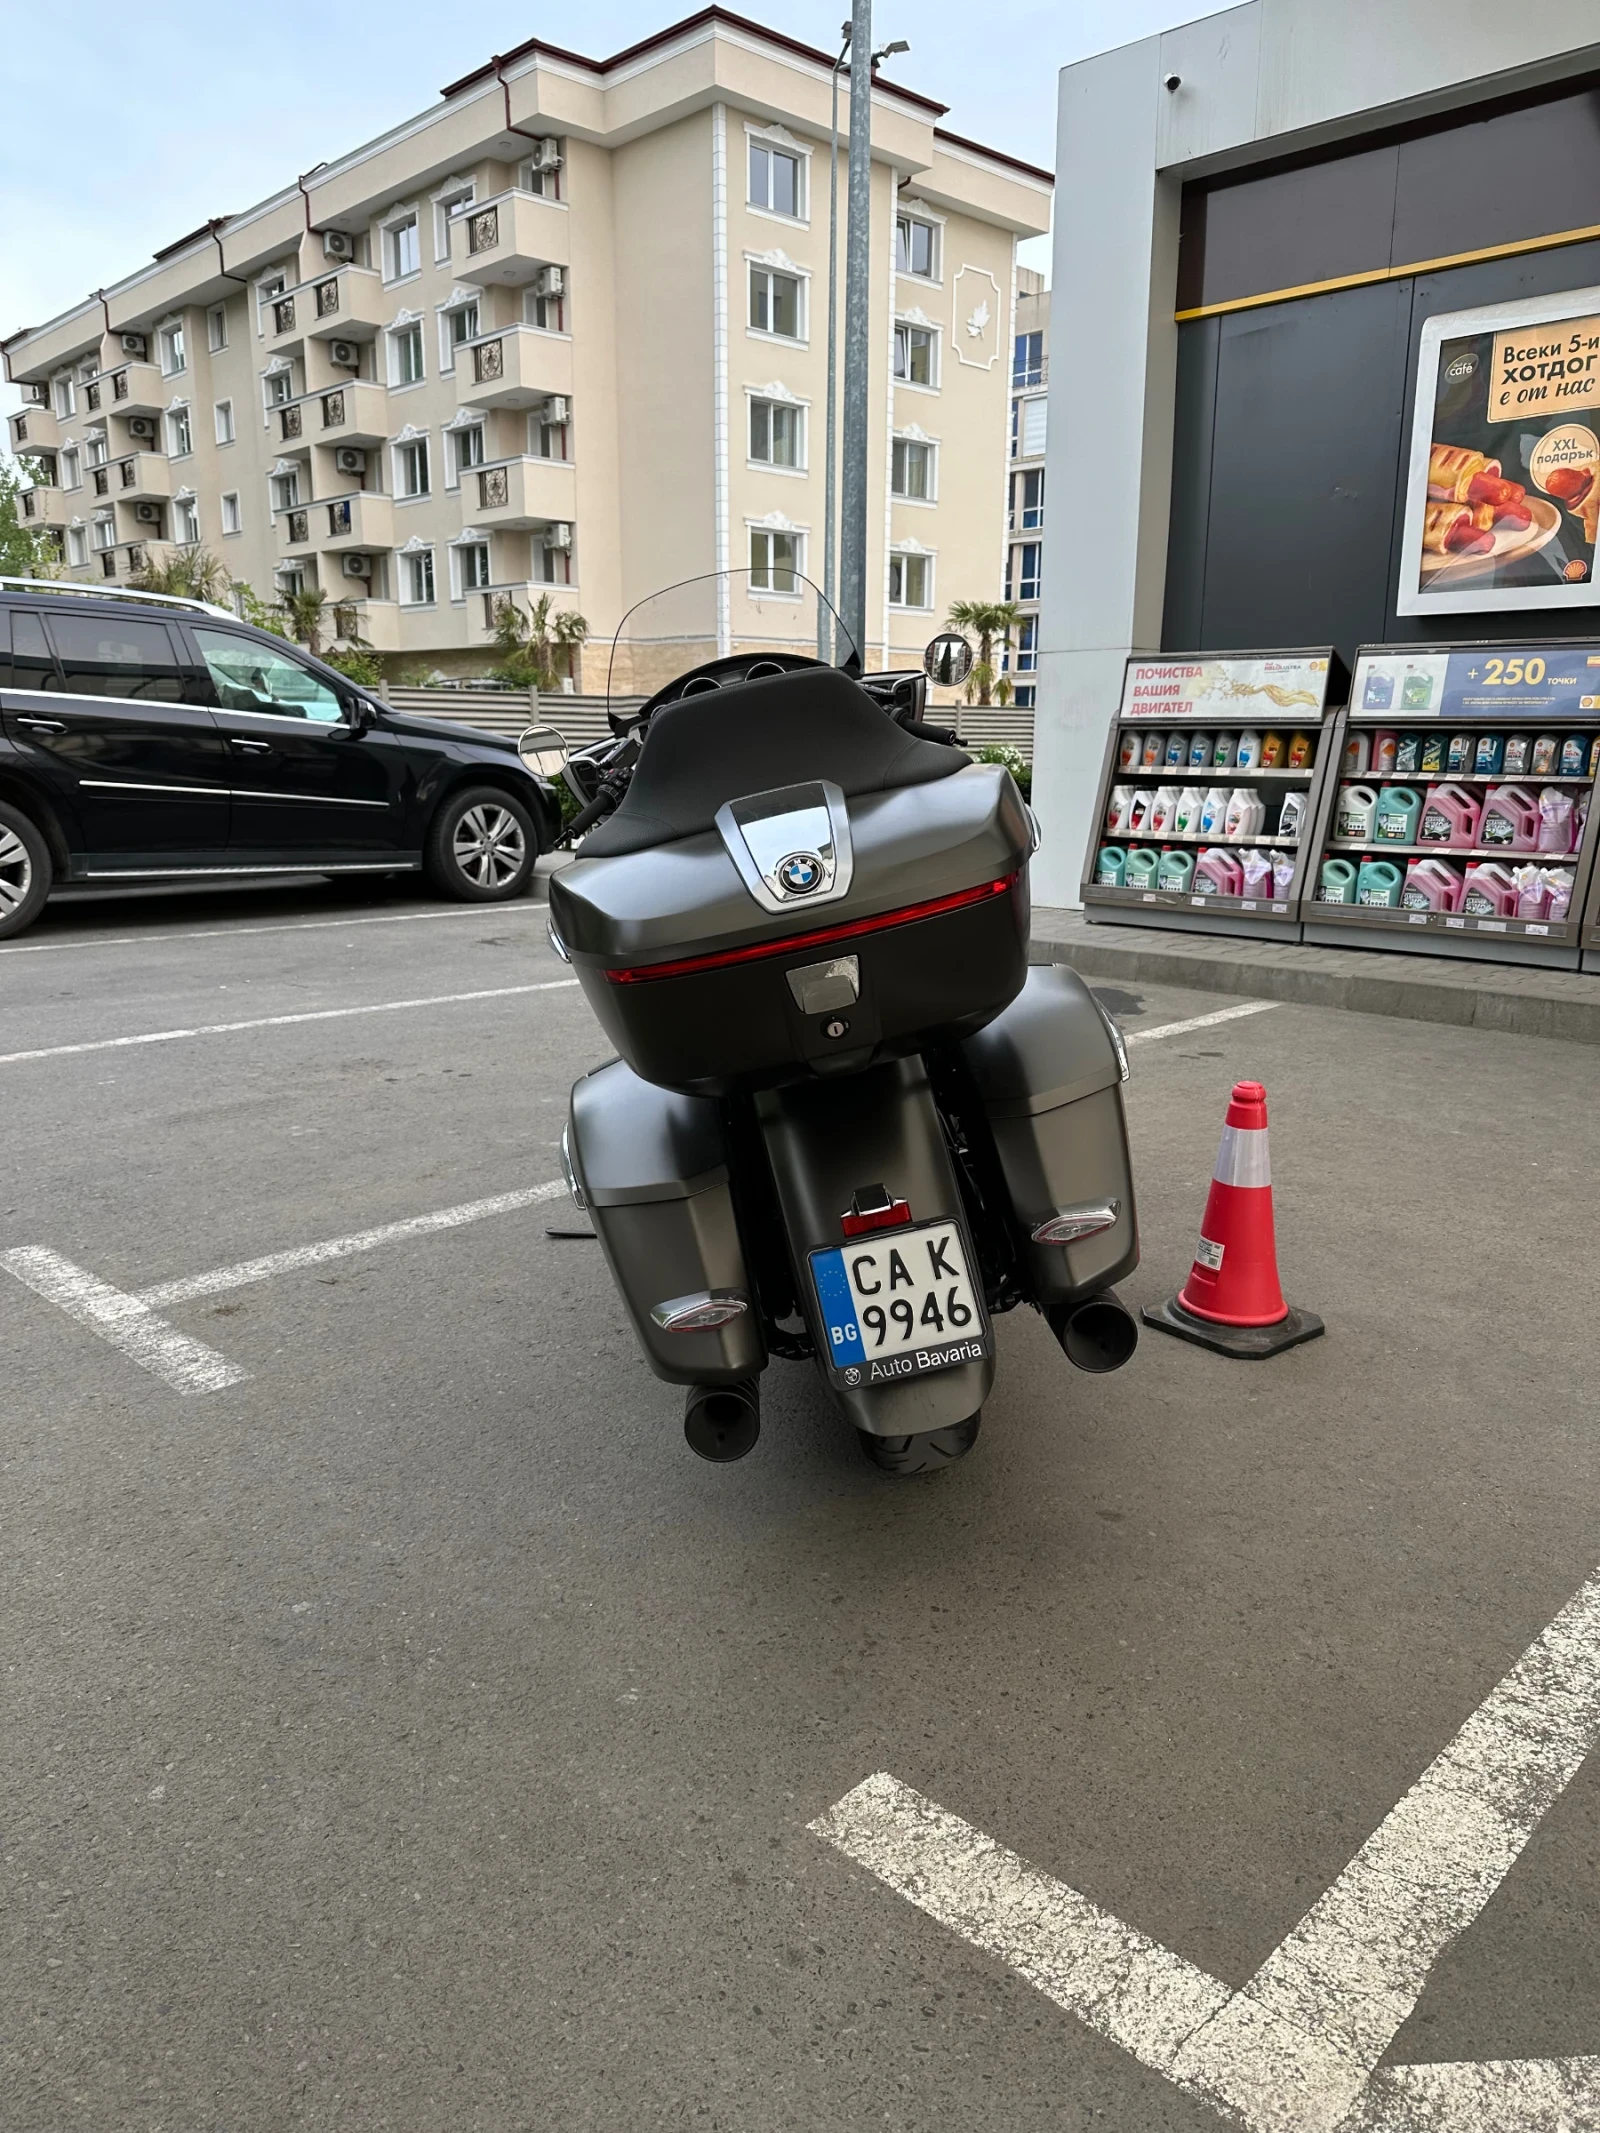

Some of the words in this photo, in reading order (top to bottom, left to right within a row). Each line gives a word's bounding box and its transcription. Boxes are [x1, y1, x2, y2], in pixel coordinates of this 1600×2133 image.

[1503, 343, 1562, 364] Всеки
[1568, 334, 1600, 353] 5-и
[1517, 386, 1548, 403] от
[1555, 378, 1596, 397] нас
[1536, 449, 1594, 464] подарък
[1552, 438, 1578, 452] XXL
[1135, 666, 1203, 680] ПОЧИСТВА
[1481, 657, 1546, 686] 250
[1133, 684, 1181, 697] ВАШИЯ
[1130, 701, 1193, 715] ДВИГАТЕЛ
[784, 858, 814, 872] BMW
[926, 1235, 960, 1280] K
[862, 1285, 972, 1347] 9946
[830, 1323, 858, 1346] BG
[870, 1358, 913, 1381] Auto
[915, 1341, 983, 1369] Bavaria
